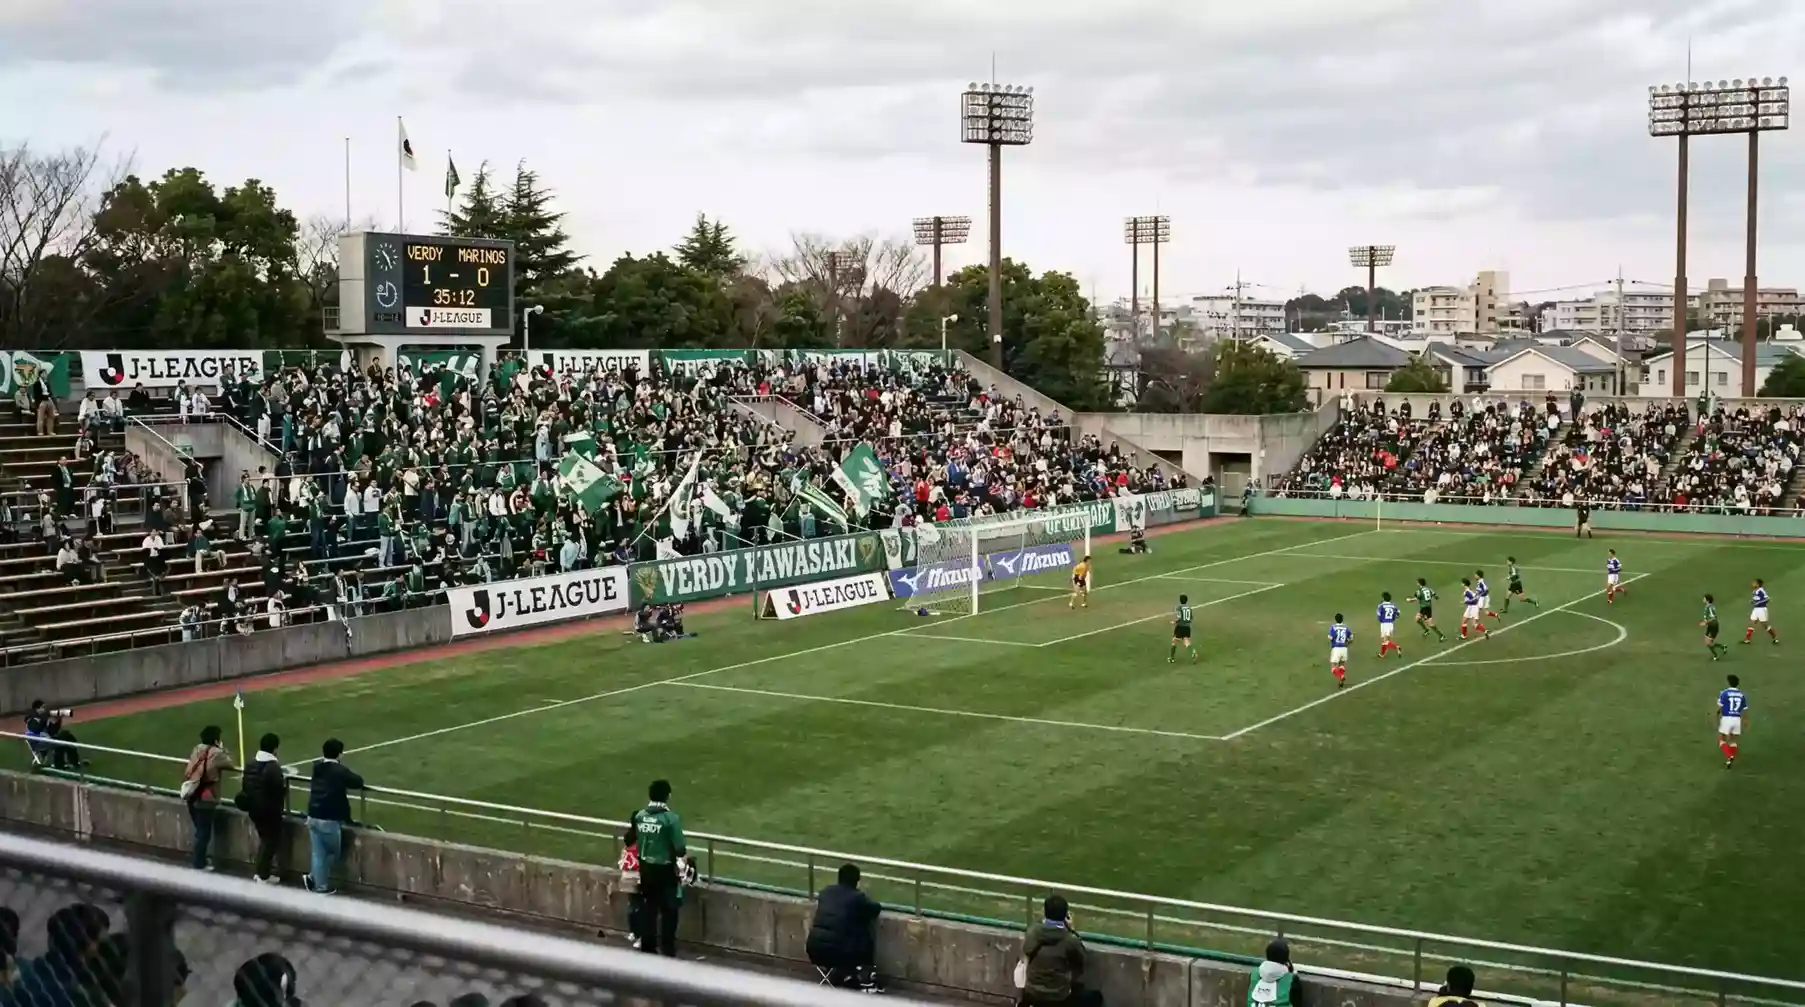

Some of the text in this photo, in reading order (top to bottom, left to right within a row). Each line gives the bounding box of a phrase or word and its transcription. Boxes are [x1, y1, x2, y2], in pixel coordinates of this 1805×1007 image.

[408, 245, 506, 264] VERDY MARINOS
[423, 264, 431, 285] 1
[478, 267, 489, 287] 0
[434, 289, 475, 305] 35:12
[432, 312, 483, 324] J-LEAGUE
[658, 538, 857, 597] VERDY KAWASAKI
[495, 576, 617, 620] J-LEAGUE
[803, 580, 878, 609] J-LEAGUE
[1183, 609, 1190, 621] 10
[1728, 697, 1742, 711] 17
